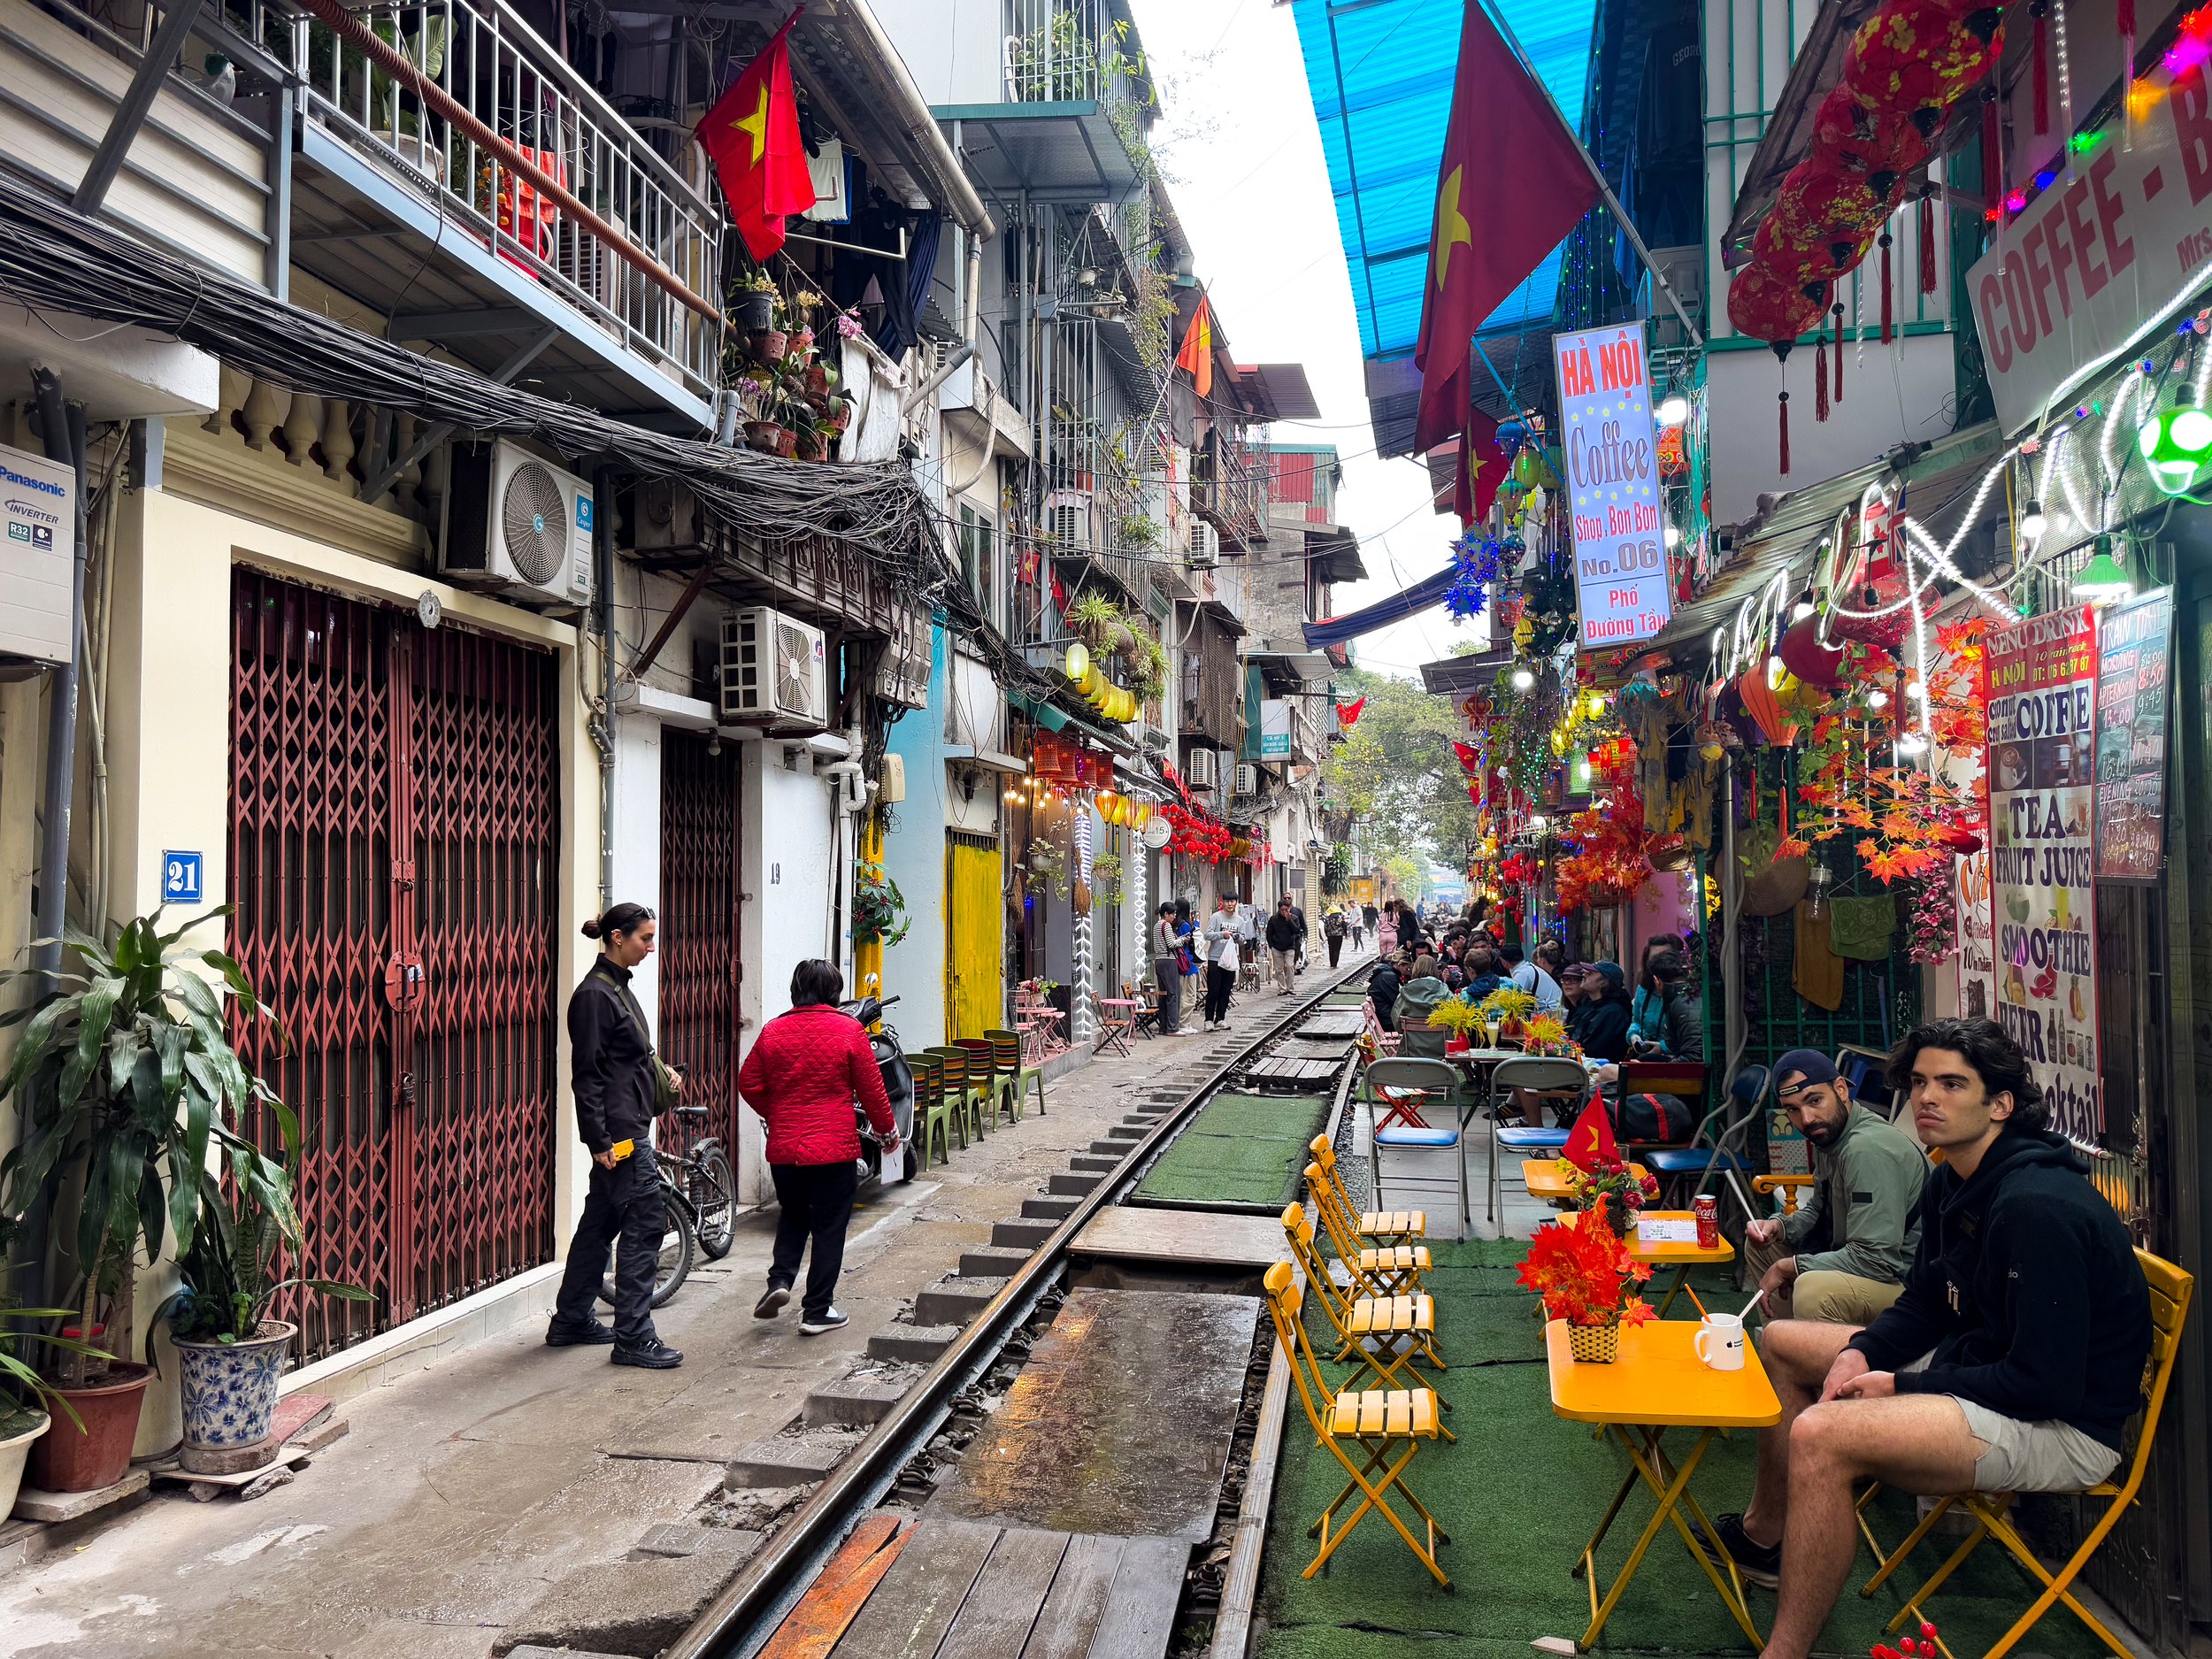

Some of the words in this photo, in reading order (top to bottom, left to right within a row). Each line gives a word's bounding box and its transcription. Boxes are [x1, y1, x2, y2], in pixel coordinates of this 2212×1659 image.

[1980, 146, 2137, 373] COFFEE
[1561, 338, 1595, 398] HÀ
[1600, 330, 1643, 399] NỘI
[1571, 419, 1650, 488] Coffee
[0, 465, 65, 497] Panasonic
[9, 503, 59, 525] INVERTER
[11, 523, 28, 536] R32
[577, 516, 591, 528] Casper
[1608, 504, 1632, 536] Bon
[1633, 501, 1658, 532] Bon
[1609, 583, 1639, 609] Phố
[1586, 617, 1634, 639] Đường
[1986, 626, 2028, 658] MENU
[2032, 608, 2090, 646] DRINK
[2101, 614, 2131, 654] TRAIN
[2139, 664, 2163, 690] 8:50
[2016, 686, 2089, 739] COFFE
[2138, 686, 2162, 715] 9:45
[2100, 780, 2132, 803] EVENING
[2009, 795, 2066, 839] TEA
[168, 861, 198, 892] 21
[771, 863, 780, 885] 19
[1994, 847, 2035, 886] FRUIT
[2039, 847, 2092, 888] JUICE
[2001, 923, 2091, 977] SMOOTHIE
[1998, 1002, 2047, 1064] BEER
